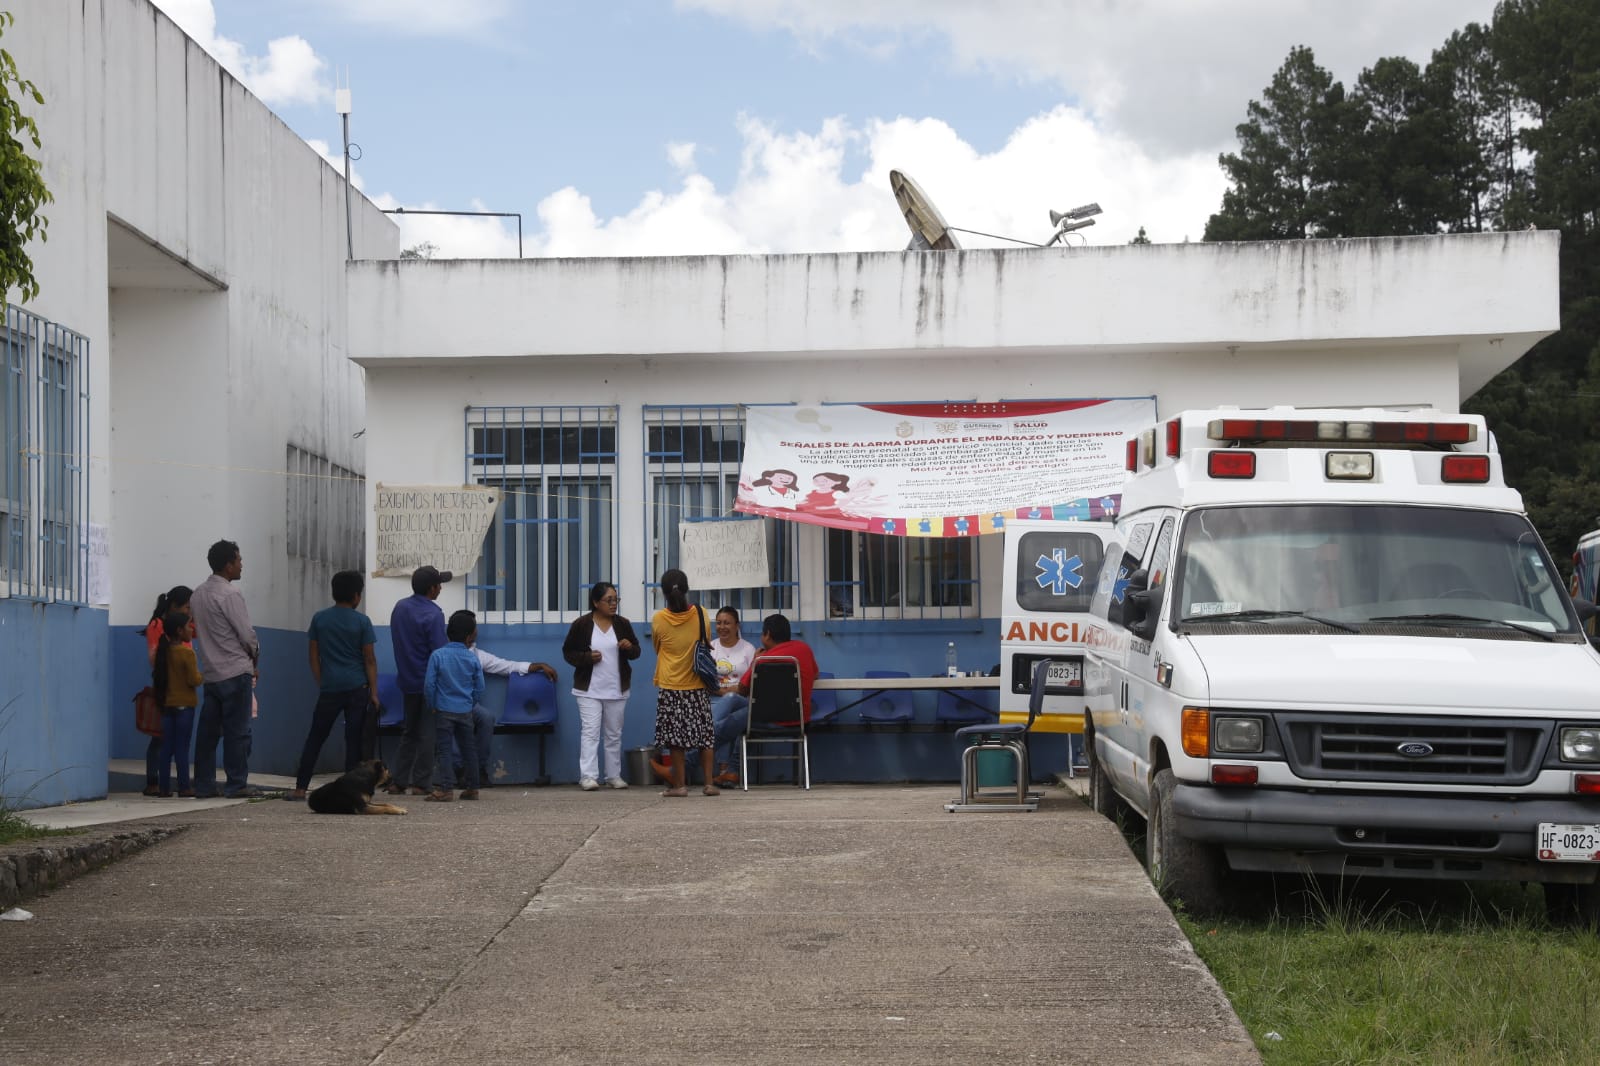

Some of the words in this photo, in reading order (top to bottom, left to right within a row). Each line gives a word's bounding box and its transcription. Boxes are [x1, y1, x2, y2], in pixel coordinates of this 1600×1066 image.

[779, 441, 832, 449] SEÑALES
[852, 440, 902, 448] ALARMA
[904, 438, 959, 446] DURANTE
[981, 434, 1045, 442] EMBARAZO
[1056, 431, 1124, 440] PUERPERIO
[798, 453, 876, 461] complicaciones
[878, 451, 926, 459] asociadas
[1033, 443, 1083, 451] puerperio
[852, 456, 907, 465] principales
[960, 450, 1022, 459] enfermedad
[869, 447, 911, 455] prenatal
[910, 465, 947, 473] Motivo
[949, 464, 970, 472] por
[929, 457, 993, 466] reproductiva
[378, 492, 431, 510] EXIGIMOS
[377, 513, 453, 533] CONDICIONES
[455, 513, 472, 533] EN
[475, 513, 490, 533] LA
[376, 533, 468, 554] INFRAESTRUCTURA
[1000, 621, 1088, 643] ANCI
[1406, 745, 1425, 754] Ford
[1541, 832, 1600, 850] HF-0823-
